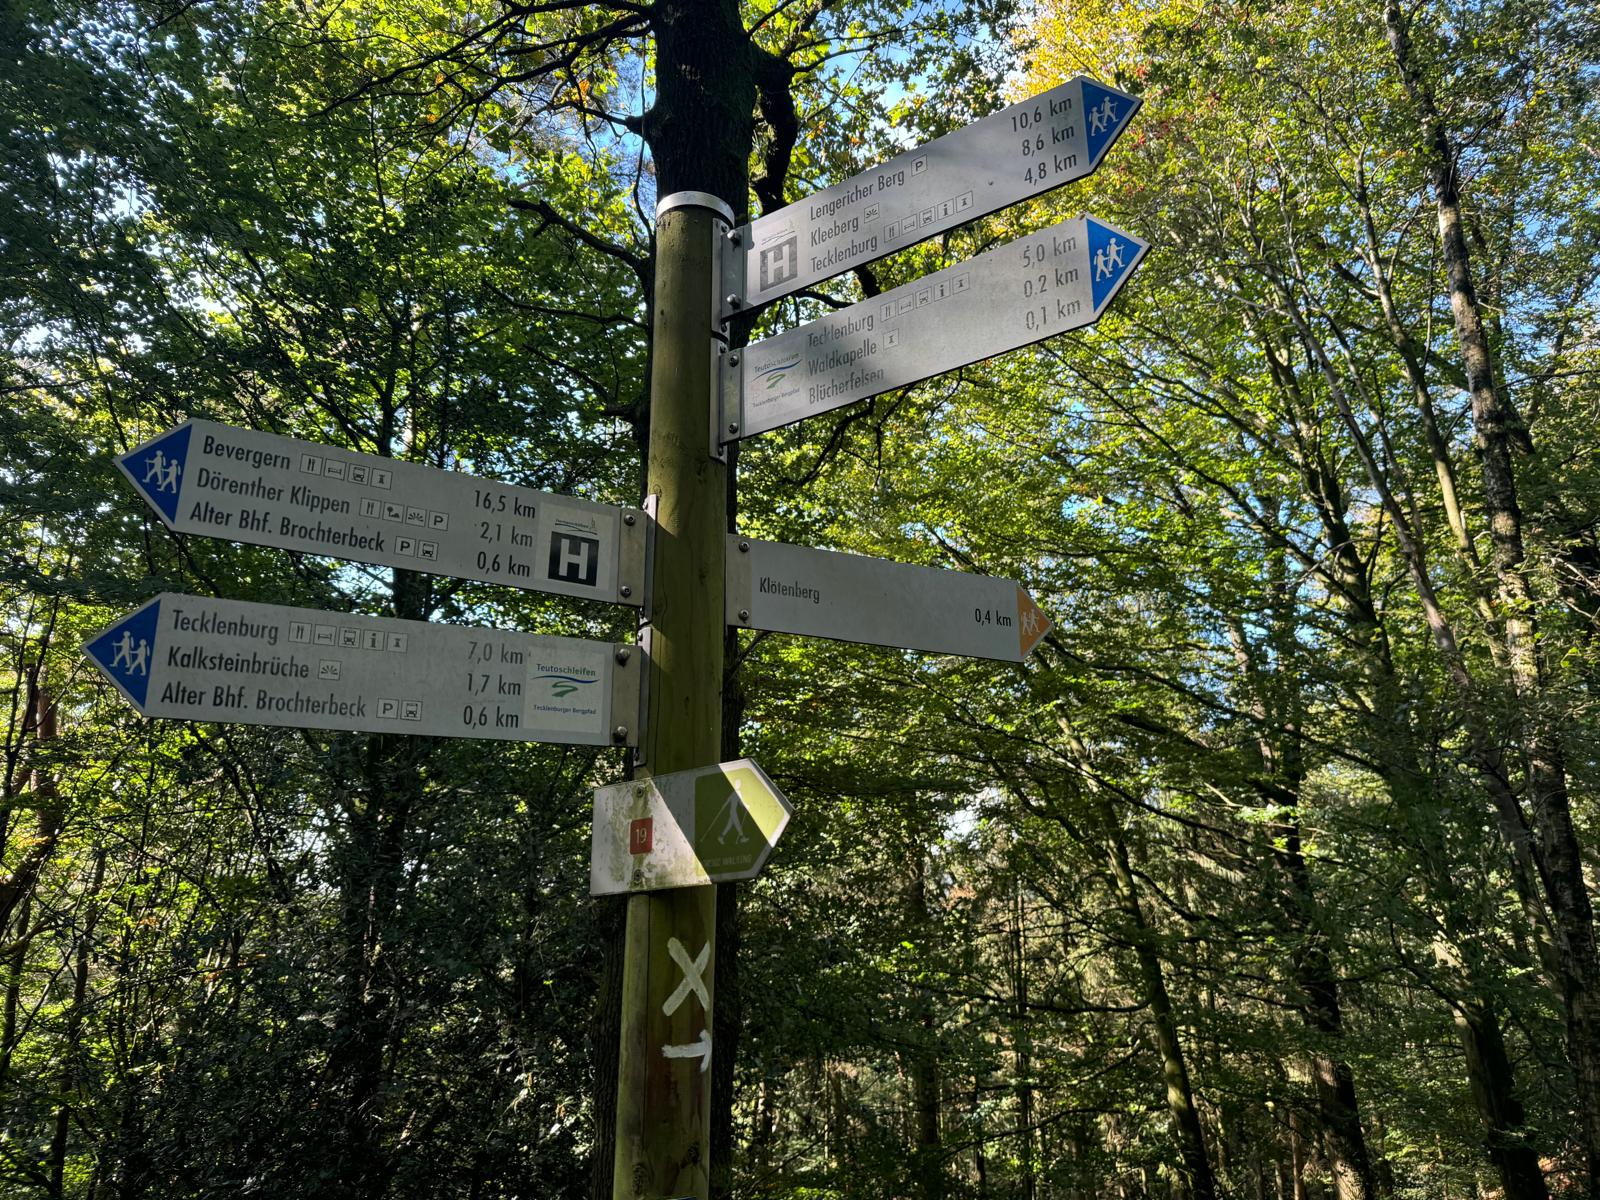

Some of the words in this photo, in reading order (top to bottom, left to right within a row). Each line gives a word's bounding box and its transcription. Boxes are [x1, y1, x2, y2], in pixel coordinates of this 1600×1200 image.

[810, 183, 874, 221] Lengericher
[878, 169, 905, 191] Berg
[1011, 105, 1042, 132] 10,6
[1049, 98, 1072, 117] km
[810, 216, 859, 247] Kleeberg
[1022, 133, 1044, 157] 8,6
[1052, 126, 1074, 144] km
[811, 235, 878, 272] Tecklenburg
[1024, 162, 1047, 186] 4,8
[1054, 154, 1077, 173] km
[807, 314, 874, 348] Tecklenburg
[1023, 244, 1045, 269] 5,0
[1053, 236, 1077, 257] km
[808, 338, 877, 377] Waldkapelle
[1055, 267, 1079, 288] km
[808, 367, 884, 405] Blücherfelsen
[1026, 306, 1047, 332] 0,1
[1057, 299, 1081, 320] km
[197, 467, 285, 502] Dörenther
[289, 485, 351, 516] Klippen
[480, 521, 502, 544] 2,1
[511, 525, 533, 548] km
[202, 434, 291, 471] Bevergern
[475, 490, 506, 514] 16,5
[513, 497, 536, 519] km
[189, 501, 233, 527] Alter
[238, 508, 272, 534] Bhf.
[279, 515, 385, 554] Brochterbeck
[477, 551, 500, 575] 0,6
[508, 555, 531, 578] km
[172, 609, 279, 647] Tecklenburg
[467, 641, 493, 665] 7,0
[501, 643, 524, 665] km
[760, 576, 820, 604] Klötenberg
[975, 608, 991, 627] 0,4
[996, 609, 1012, 627] km
[160, 681, 207, 706] Alter
[212, 685, 248, 710] Bhf.
[256, 689, 366, 718] Brochterbeck
[463, 705, 488, 730] 0,6
[496, 706, 519, 729] km
[167, 645, 309, 679] Kalksteinbrüche
[467, 672, 490, 697] 1,7
[499, 674, 521, 696] km
[536, 663, 597, 677] Teutoschleifen
[635, 827, 648, 845] 19
